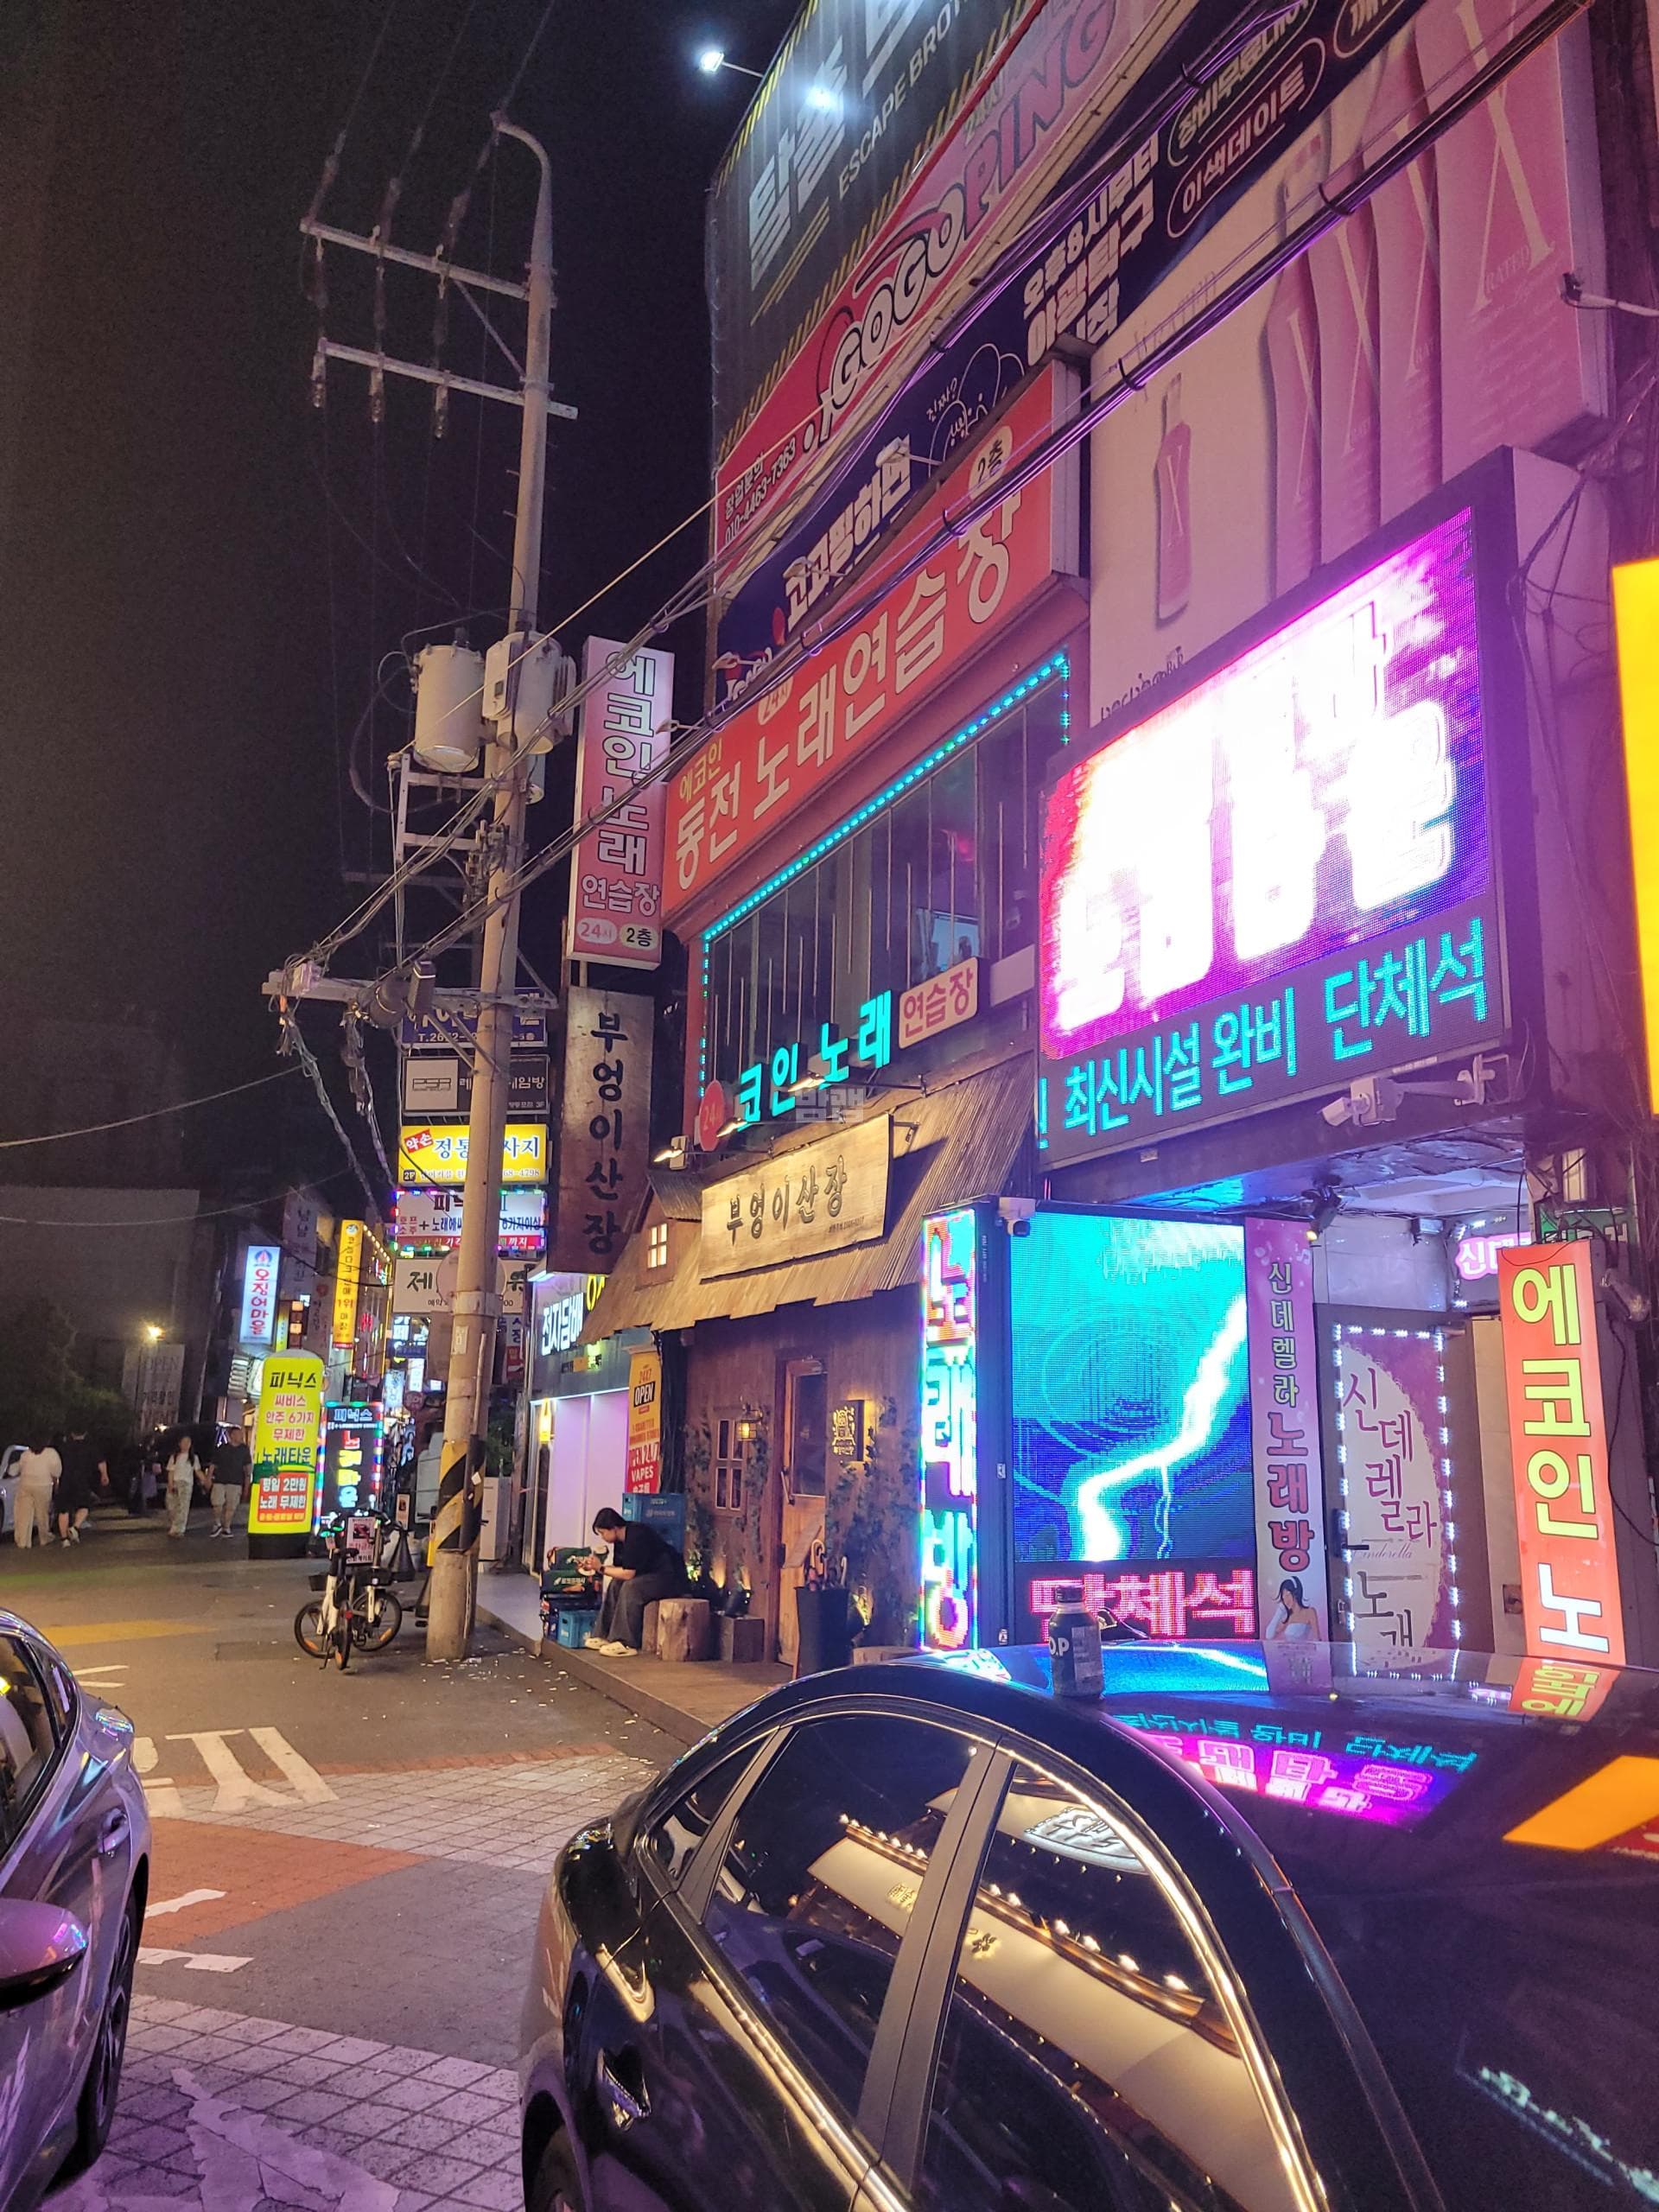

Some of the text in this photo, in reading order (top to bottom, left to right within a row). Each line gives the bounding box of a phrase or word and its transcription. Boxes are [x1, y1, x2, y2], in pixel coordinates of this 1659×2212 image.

[838, 72, 906, 200] ESCAPE
[909, 0, 965, 87] BRO
[1183, 62, 1306, 213] 이색데이트
[1024, 130, 1159, 320] 오후8시부터
[978, 439, 1005, 486] 2층
[596, 652, 655, 876] 에코인 노래
[679, 738, 722, 803] 에코인
[676, 762, 741, 889] 동전
[582, 874, 660, 917] 연습장
[626, 927, 652, 947] 2층
[737, 1042, 799, 1132] 코인
[819, 990, 891, 1090] 노래
[902, 968, 974, 1038] 연습장
[1065, 1021, 1203, 1136] 최신시설
[1211, 987, 1296, 1095] 완비
[1324, 917, 1488, 1060] 단체석
[405, 1132, 433, 1151] 약손
[582, 1012, 629, 1254] 부엉이산장
[727, 1154, 848, 1246] 부엉이산장
[249, 1268, 270, 1335] 오징어마을
[542, 1293, 584, 1357] 전자담배
[1268, 1262, 1299, 1407] 신데렐라
[270, 1371, 317, 1389] 피닉스
[275, 1394, 307, 1407] 써비스
[635, 1382, 655, 1406] OPEN
[1512, 1263, 1599, 1540] 에코인
[265, 1411, 315, 1424] 안주 6가지
[273, 1428, 305, 1441] 무제한
[334, 1408, 373, 1421] 피닉스
[924, 1224, 976, 1650] 노래방
[263, 1446, 312, 1465] 노래타운
[632, 1466, 654, 1482] VAPES
[1343, 1367, 1437, 1548] 신데렐라
[260, 1495, 307, 1510] 노래 무제한
[1266, 1412, 1314, 1573] 노래방
